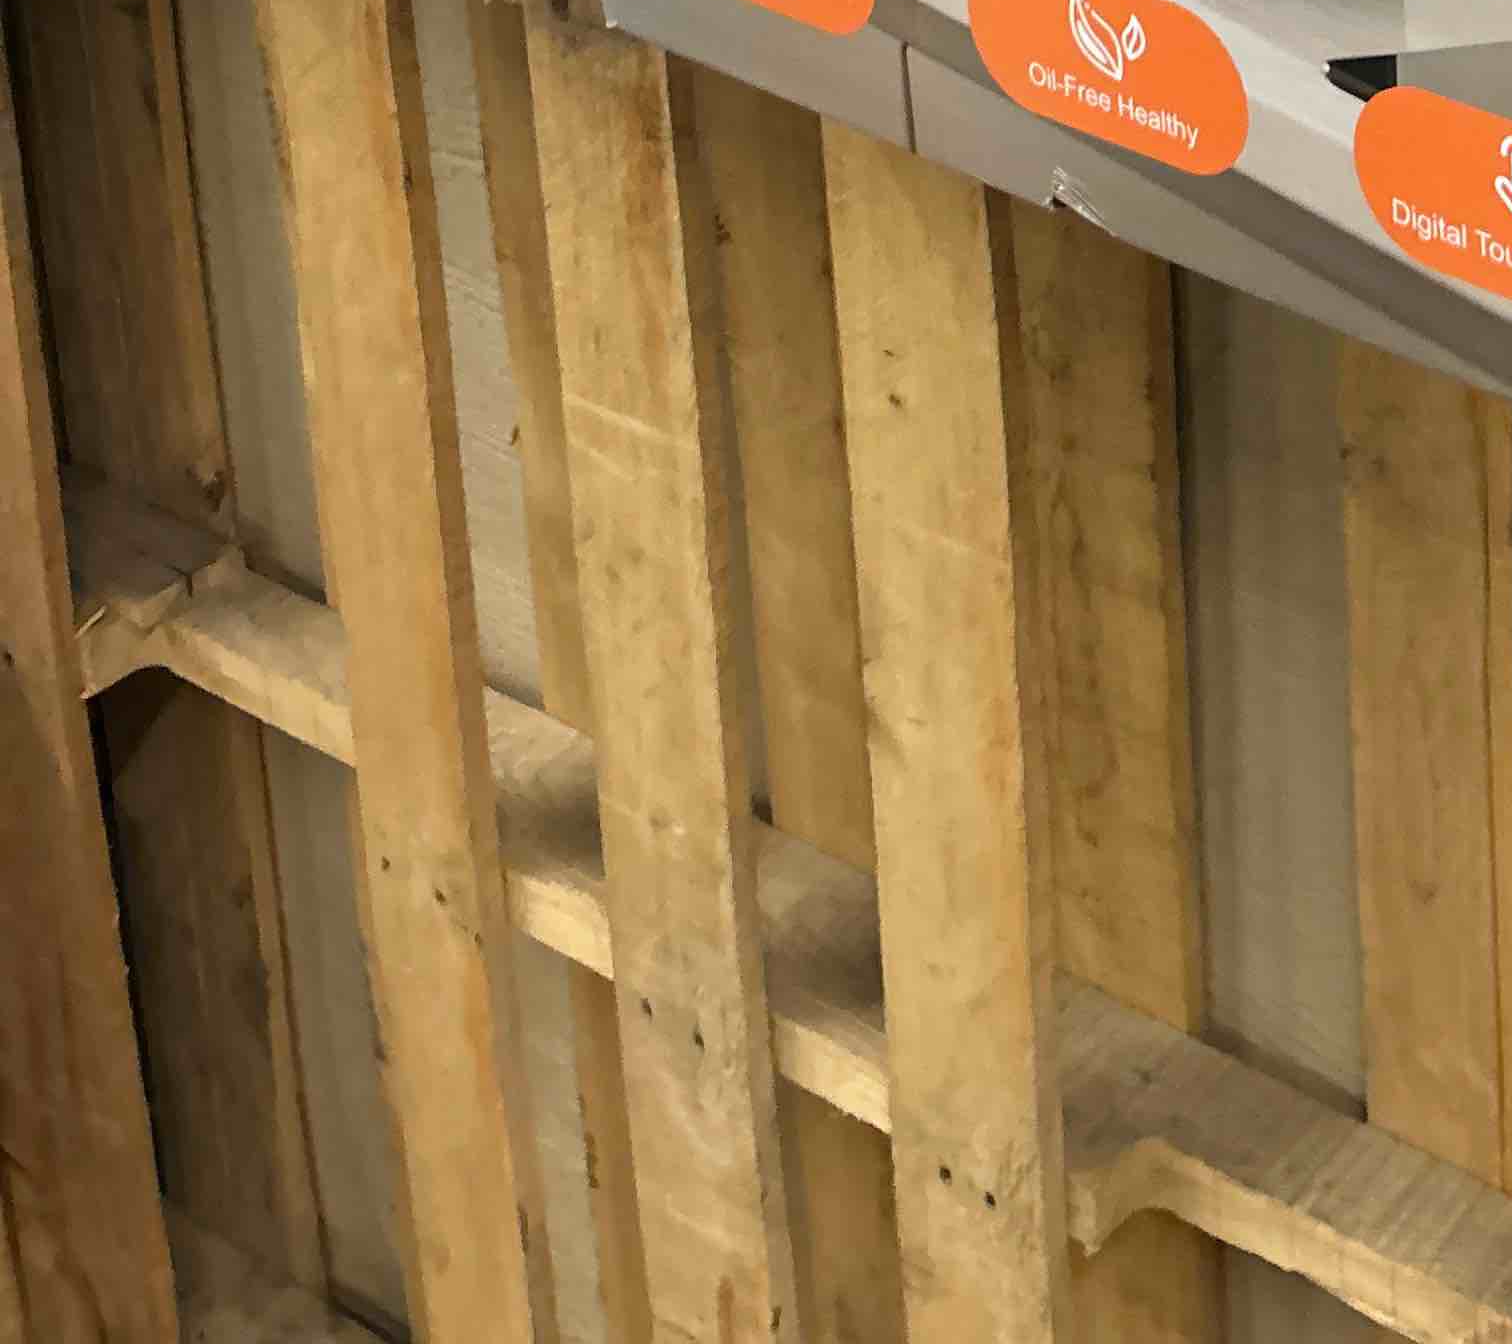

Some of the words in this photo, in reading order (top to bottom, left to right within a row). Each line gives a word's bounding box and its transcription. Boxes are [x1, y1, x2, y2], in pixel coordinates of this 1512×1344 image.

[1029, 62, 1113, 113] Oil-Free
[1120, 93, 1199, 150] Healthy
[1391, 197, 1467, 249] Digital
